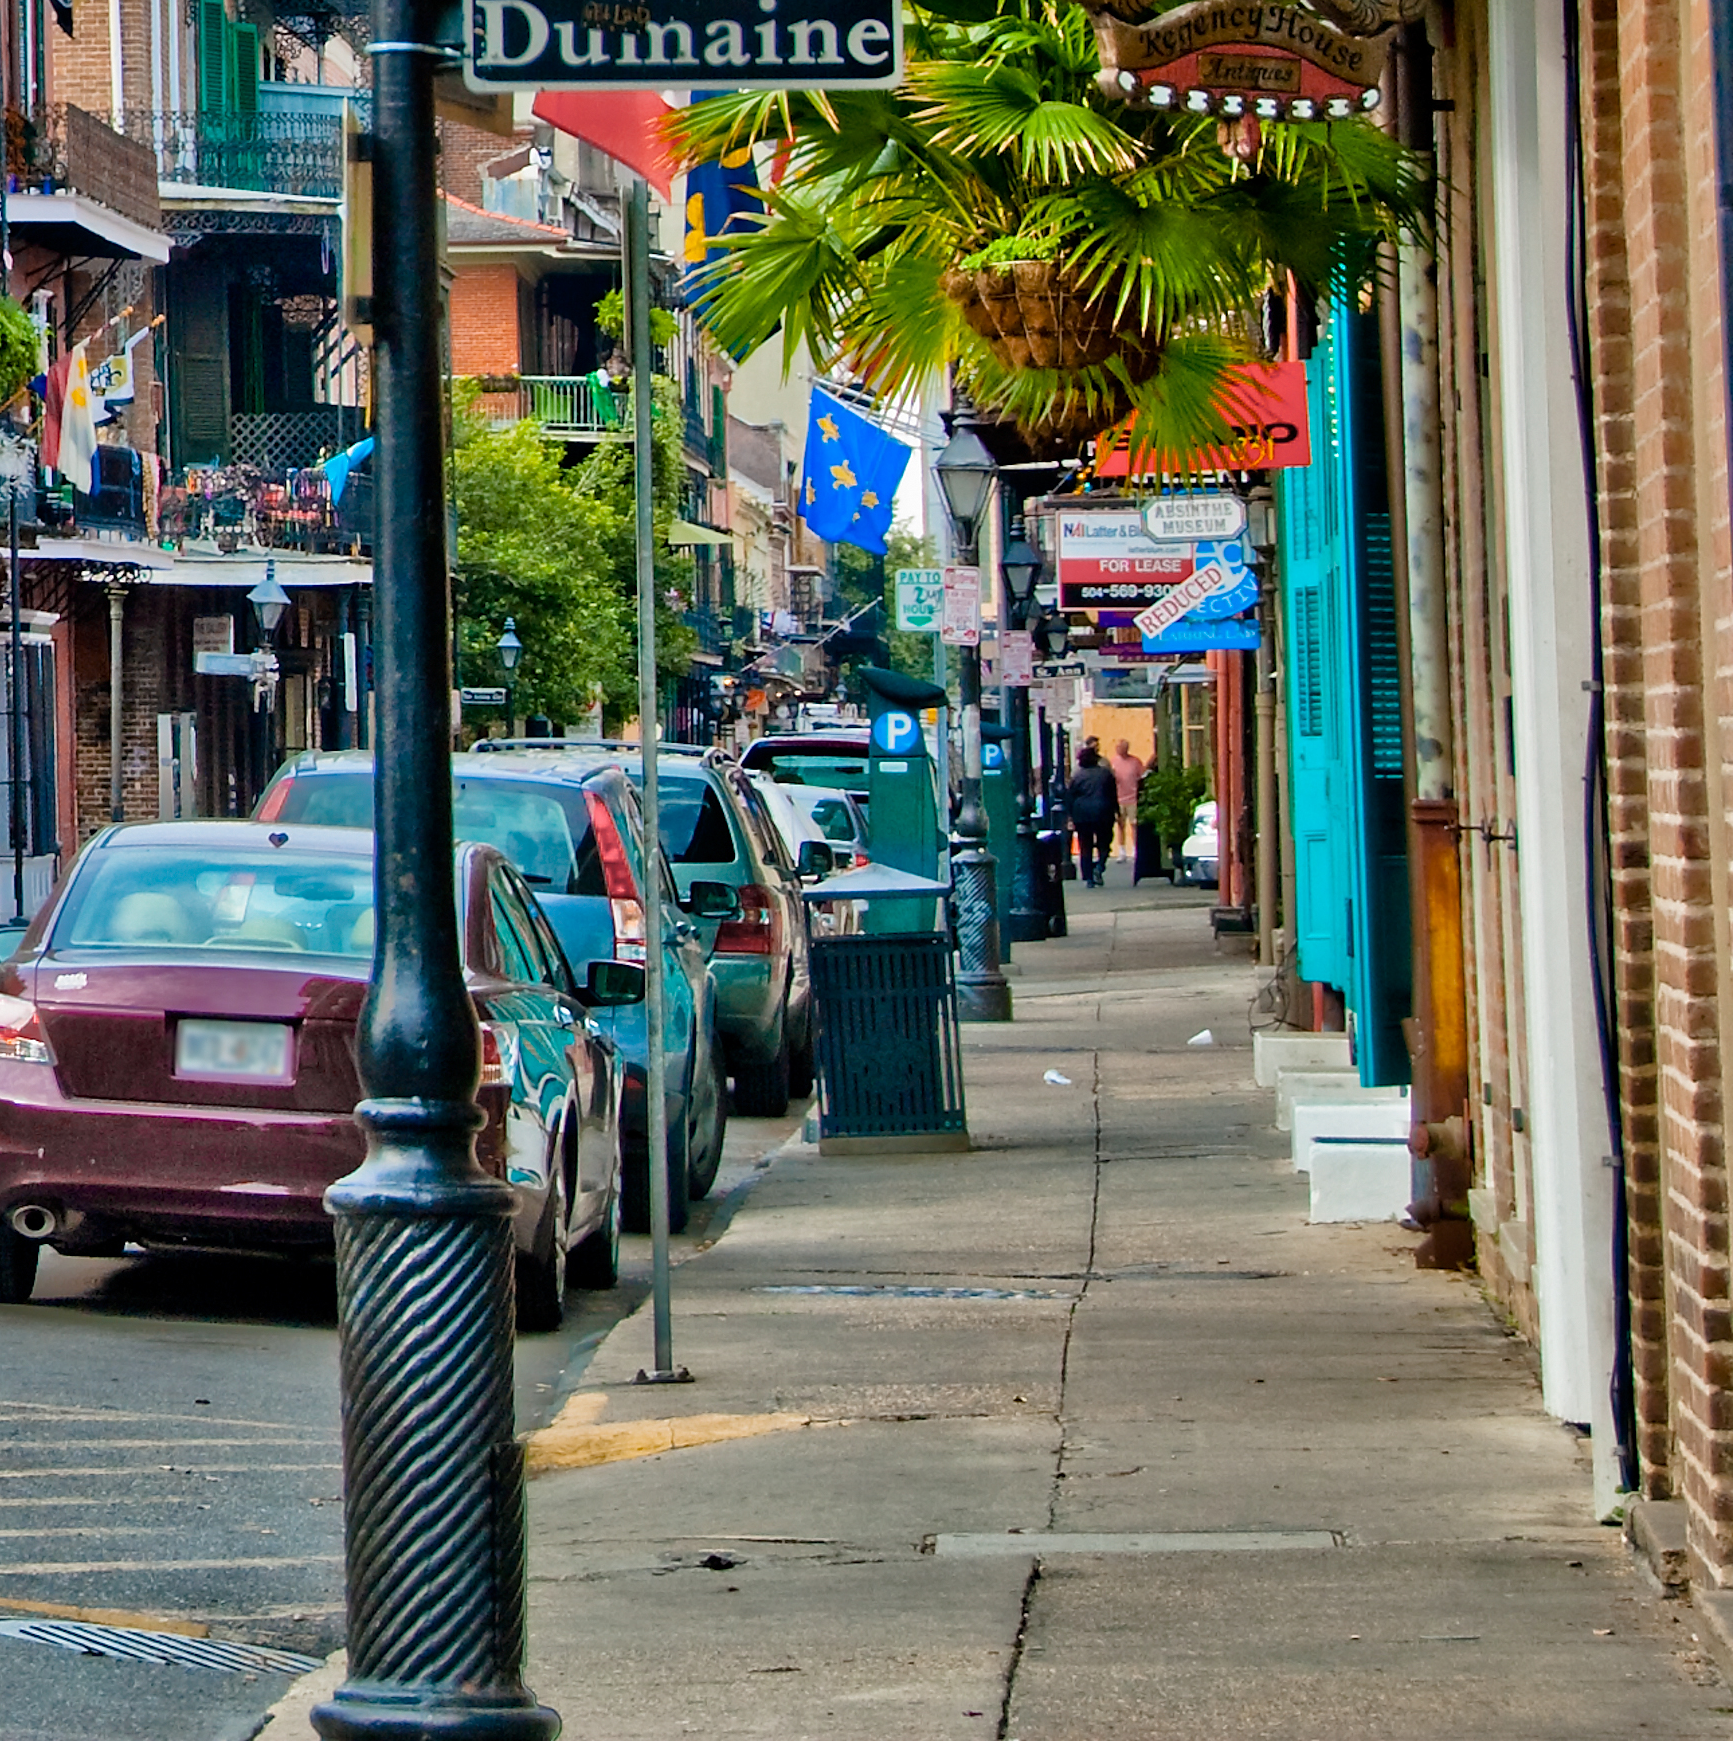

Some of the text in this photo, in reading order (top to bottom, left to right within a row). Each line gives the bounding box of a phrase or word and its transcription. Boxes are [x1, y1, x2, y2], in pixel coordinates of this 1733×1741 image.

[1264, 6, 1364, 72] House
[1154, 502, 1233, 519] ABSINTHE
[1119, 524, 1127, 538] &
[1162, 518, 1227, 534] MUSEUM
[1099, 559, 1182, 573] FOR LEASE
[900, 572, 941, 581] PAY TO
[1080, 583, 1176, 598] 504-569-930
[1138, 566, 1223, 634] REDUCED
[886, 713, 912, 750] P
[985, 743, 1000, 766] P
